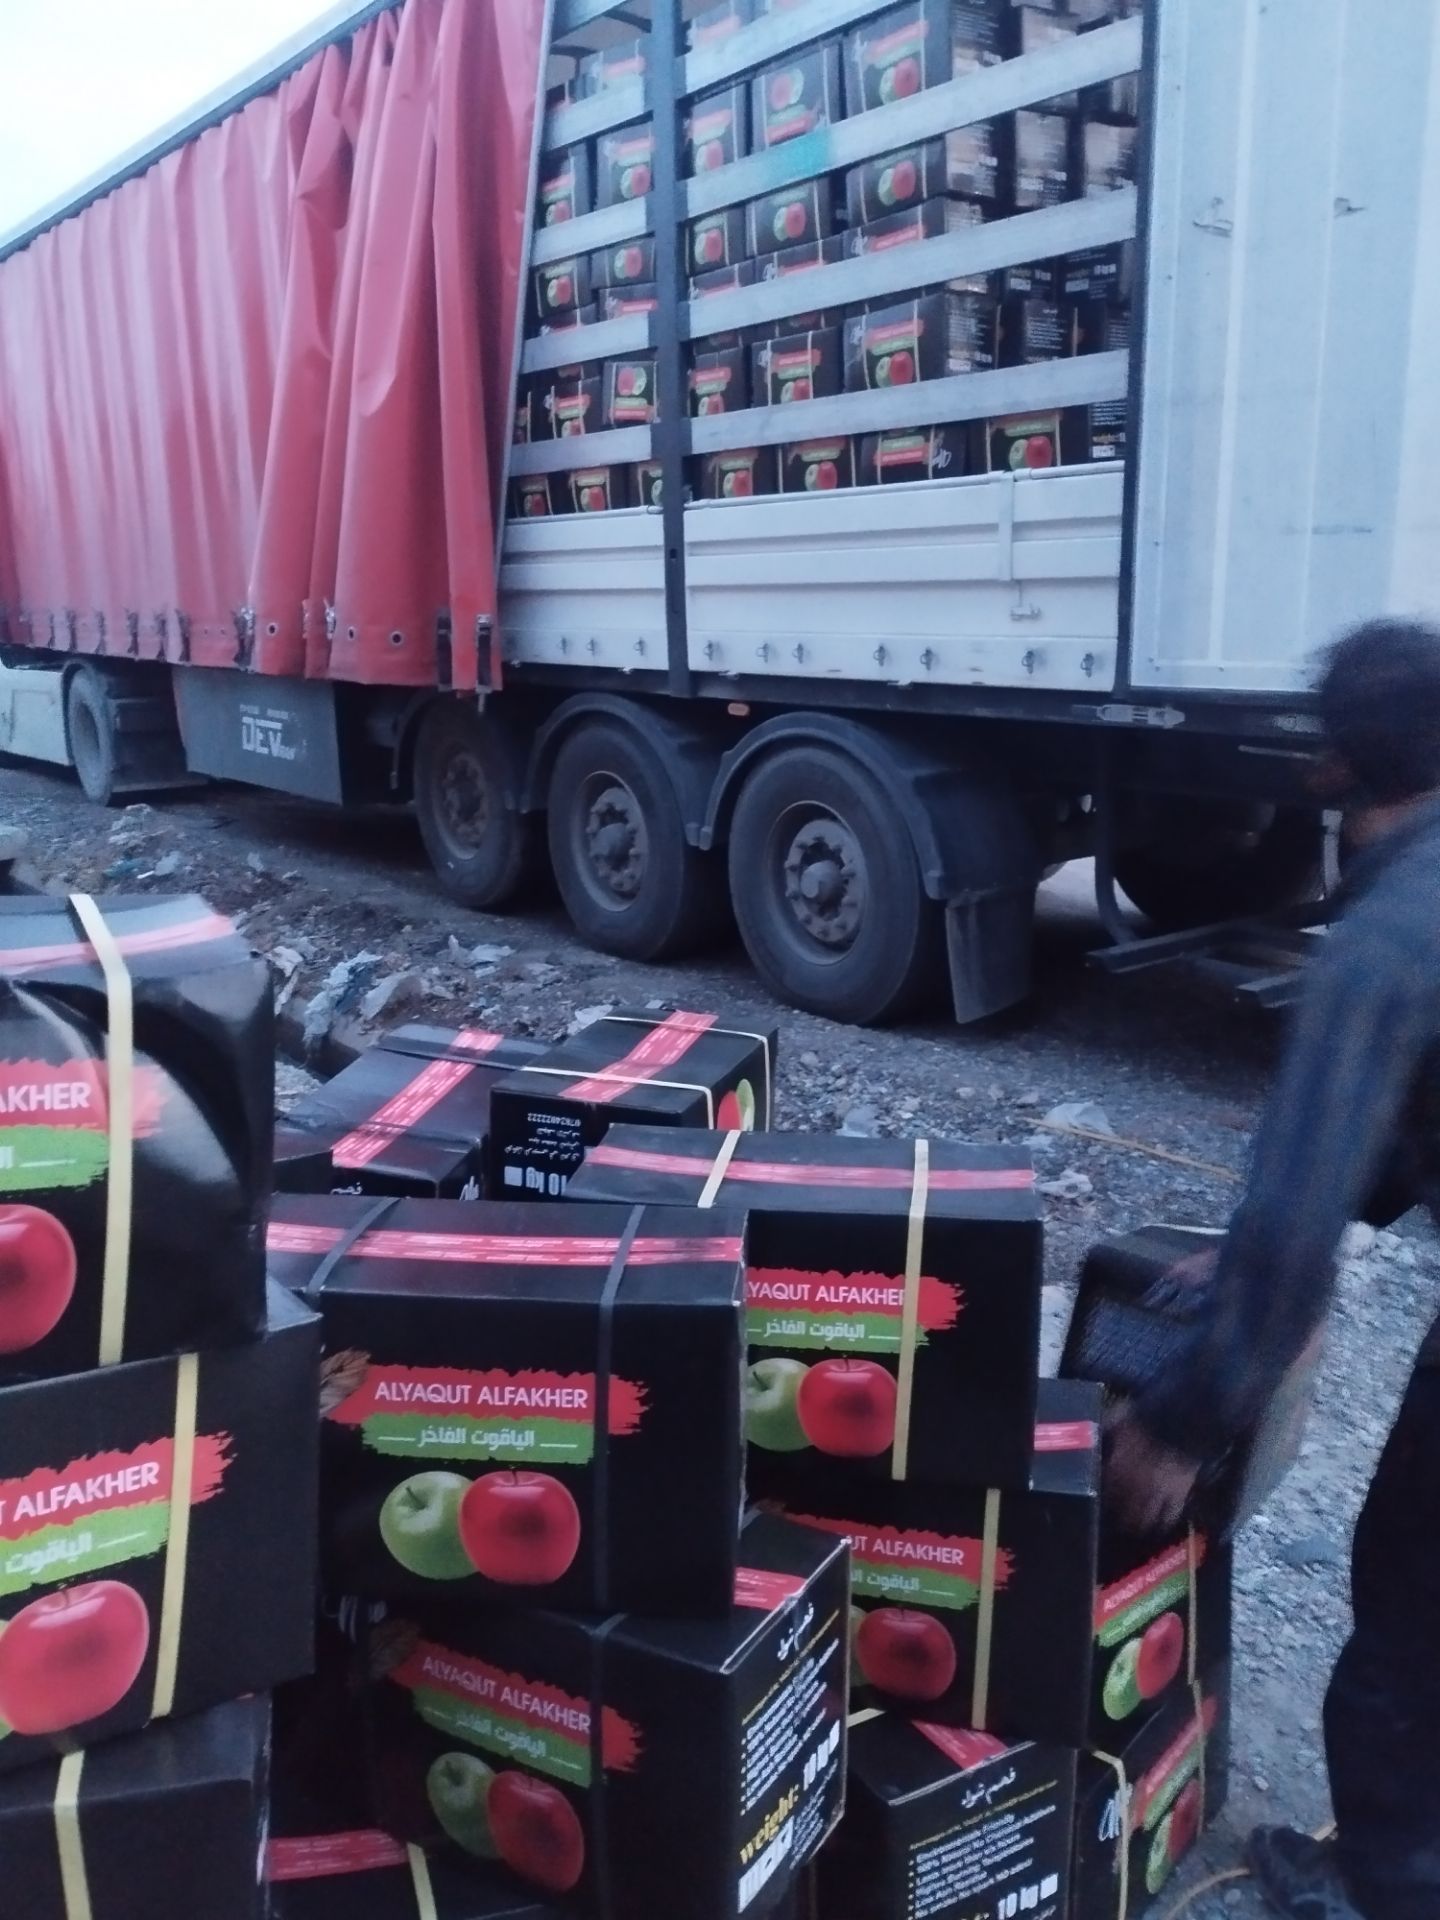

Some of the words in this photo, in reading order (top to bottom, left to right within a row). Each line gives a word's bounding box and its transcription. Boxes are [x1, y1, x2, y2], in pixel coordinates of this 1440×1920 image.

[747, 1281, 811, 1301] YAQUT
[763, 1318, 806, 1338] الفاخر
[809, 1322, 865, 1342] الياقوت
[375, 1381, 472, 1404] ALYAQUT
[477, 1386, 588, 1409] ALFAKHER
[417, 1425, 466, 1448] الفاخر
[471, 1428, 535, 1451] الياقوت
[13, 1461, 161, 1523] ALFAKHER
[872, 1538, 965, 1566] ALFAKHER
[500, 1686, 592, 1735] ALFAKHER
